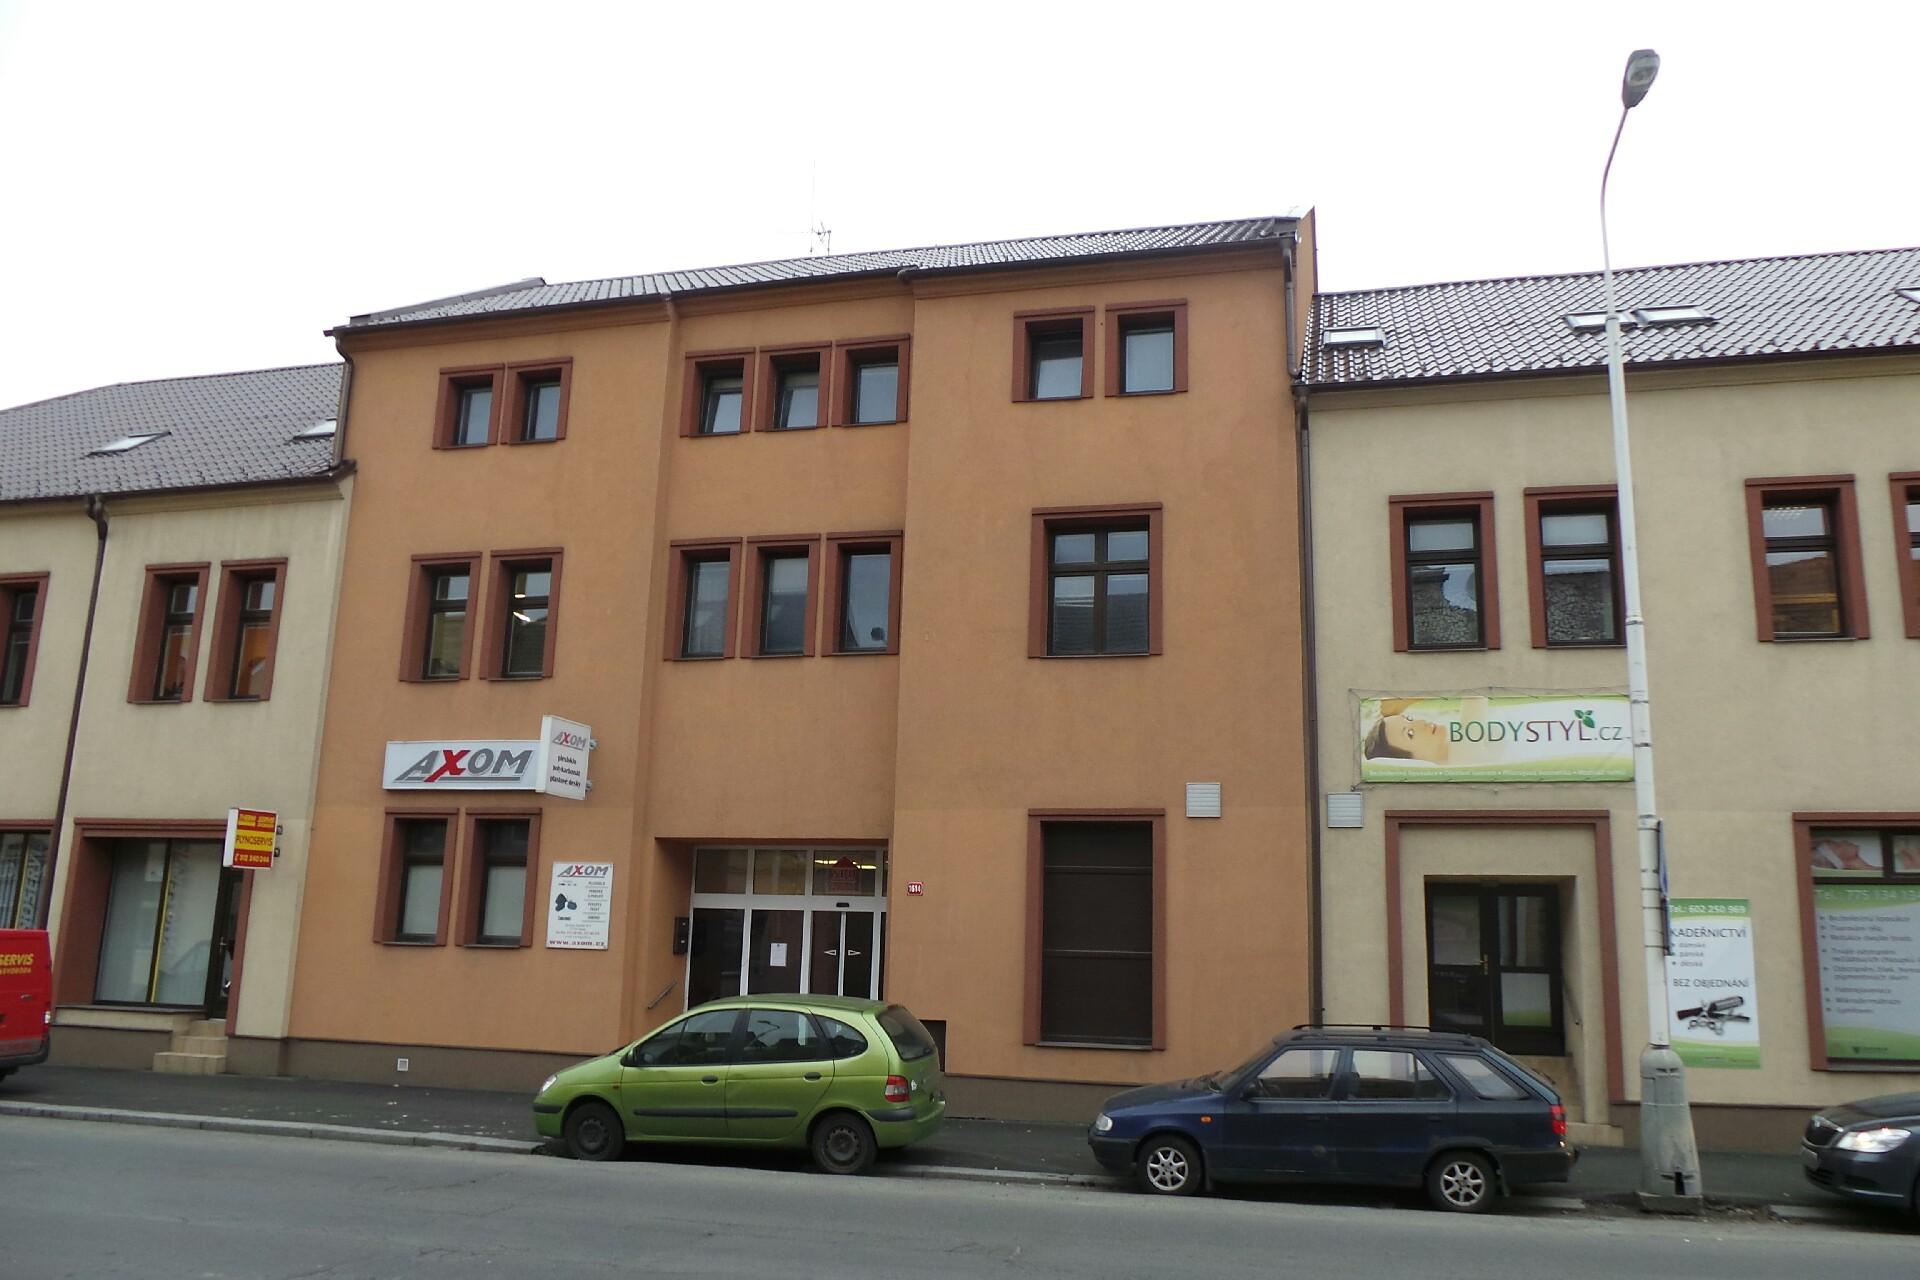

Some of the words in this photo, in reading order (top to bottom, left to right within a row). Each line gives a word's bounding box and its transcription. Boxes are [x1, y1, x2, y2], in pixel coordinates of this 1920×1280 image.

[553, 731, 587, 751] AXOM
[393, 748, 533, 782] AXOM
[557, 865, 609, 878] AXOM
